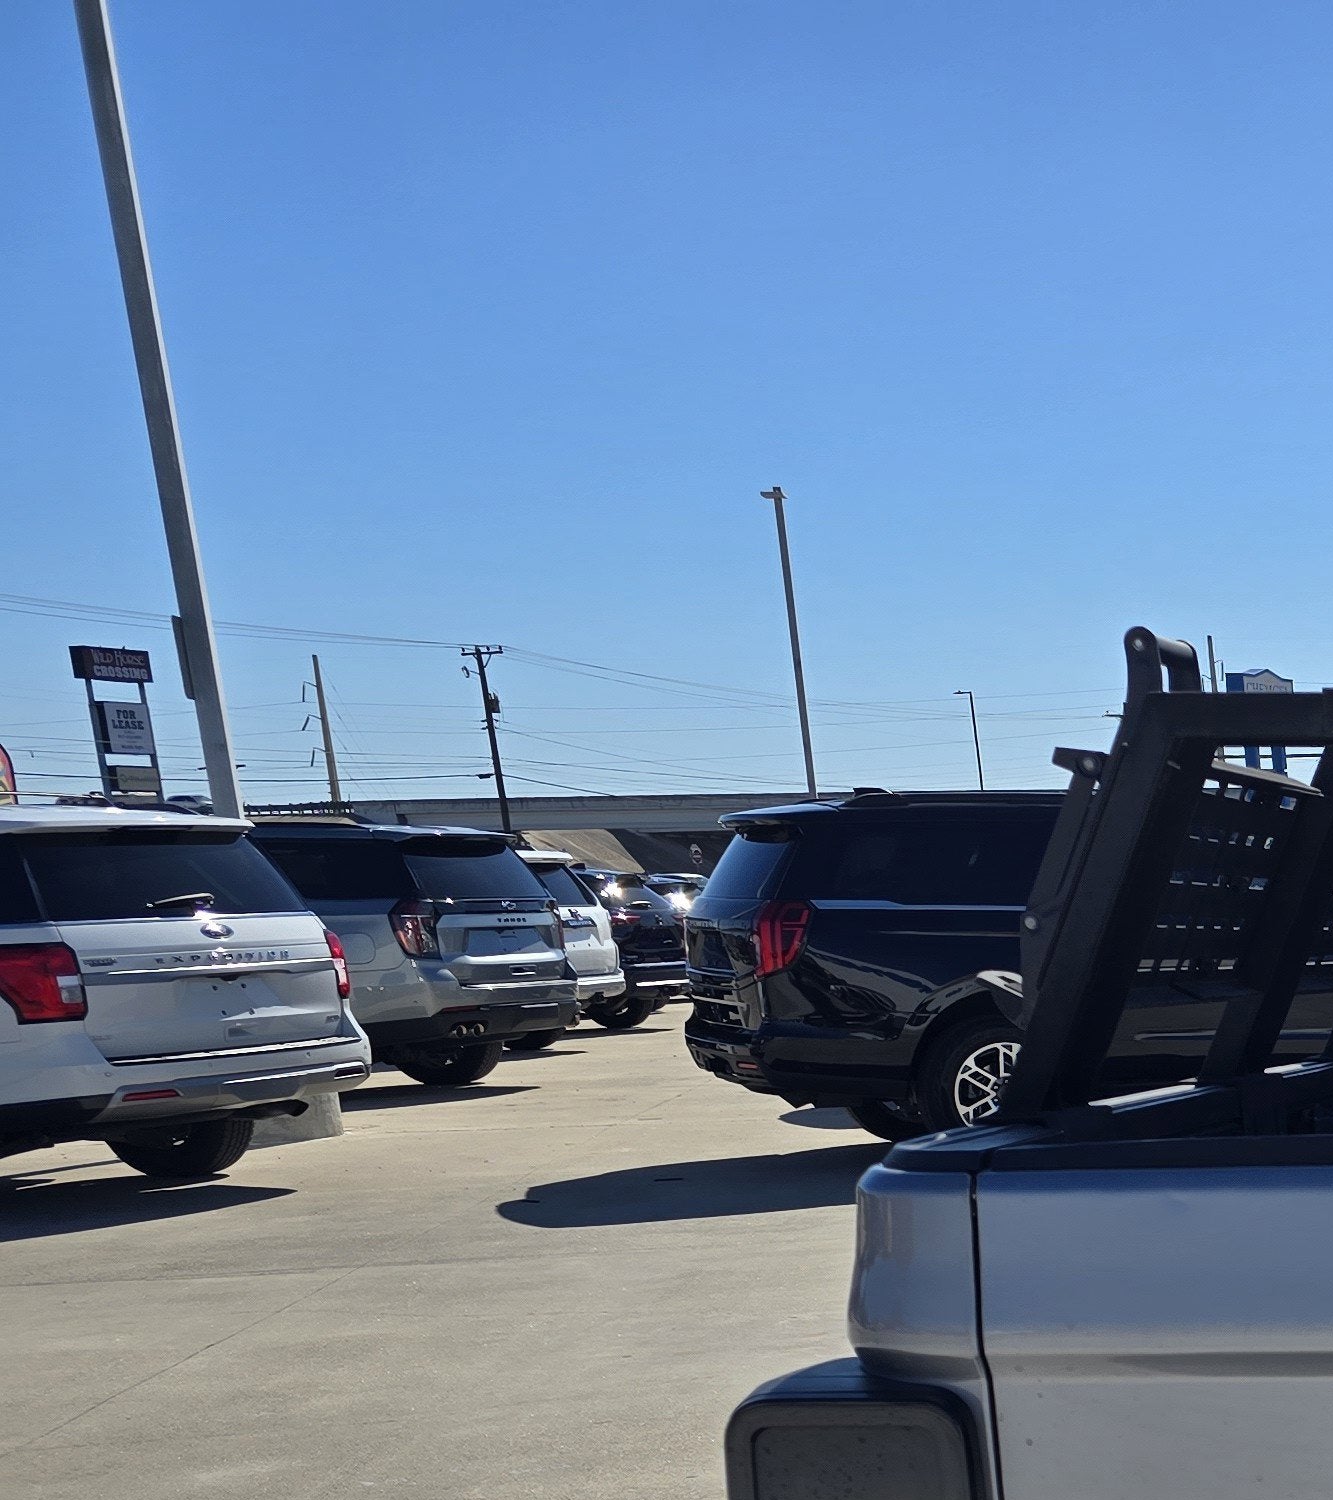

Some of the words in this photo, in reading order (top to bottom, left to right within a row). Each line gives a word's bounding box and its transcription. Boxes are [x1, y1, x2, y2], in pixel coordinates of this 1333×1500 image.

[114, 650, 146, 666] HORSE
[93, 665, 148, 679] CROSSING
[116, 709, 136, 720] FOR
[111, 719, 145, 730] LEASE
